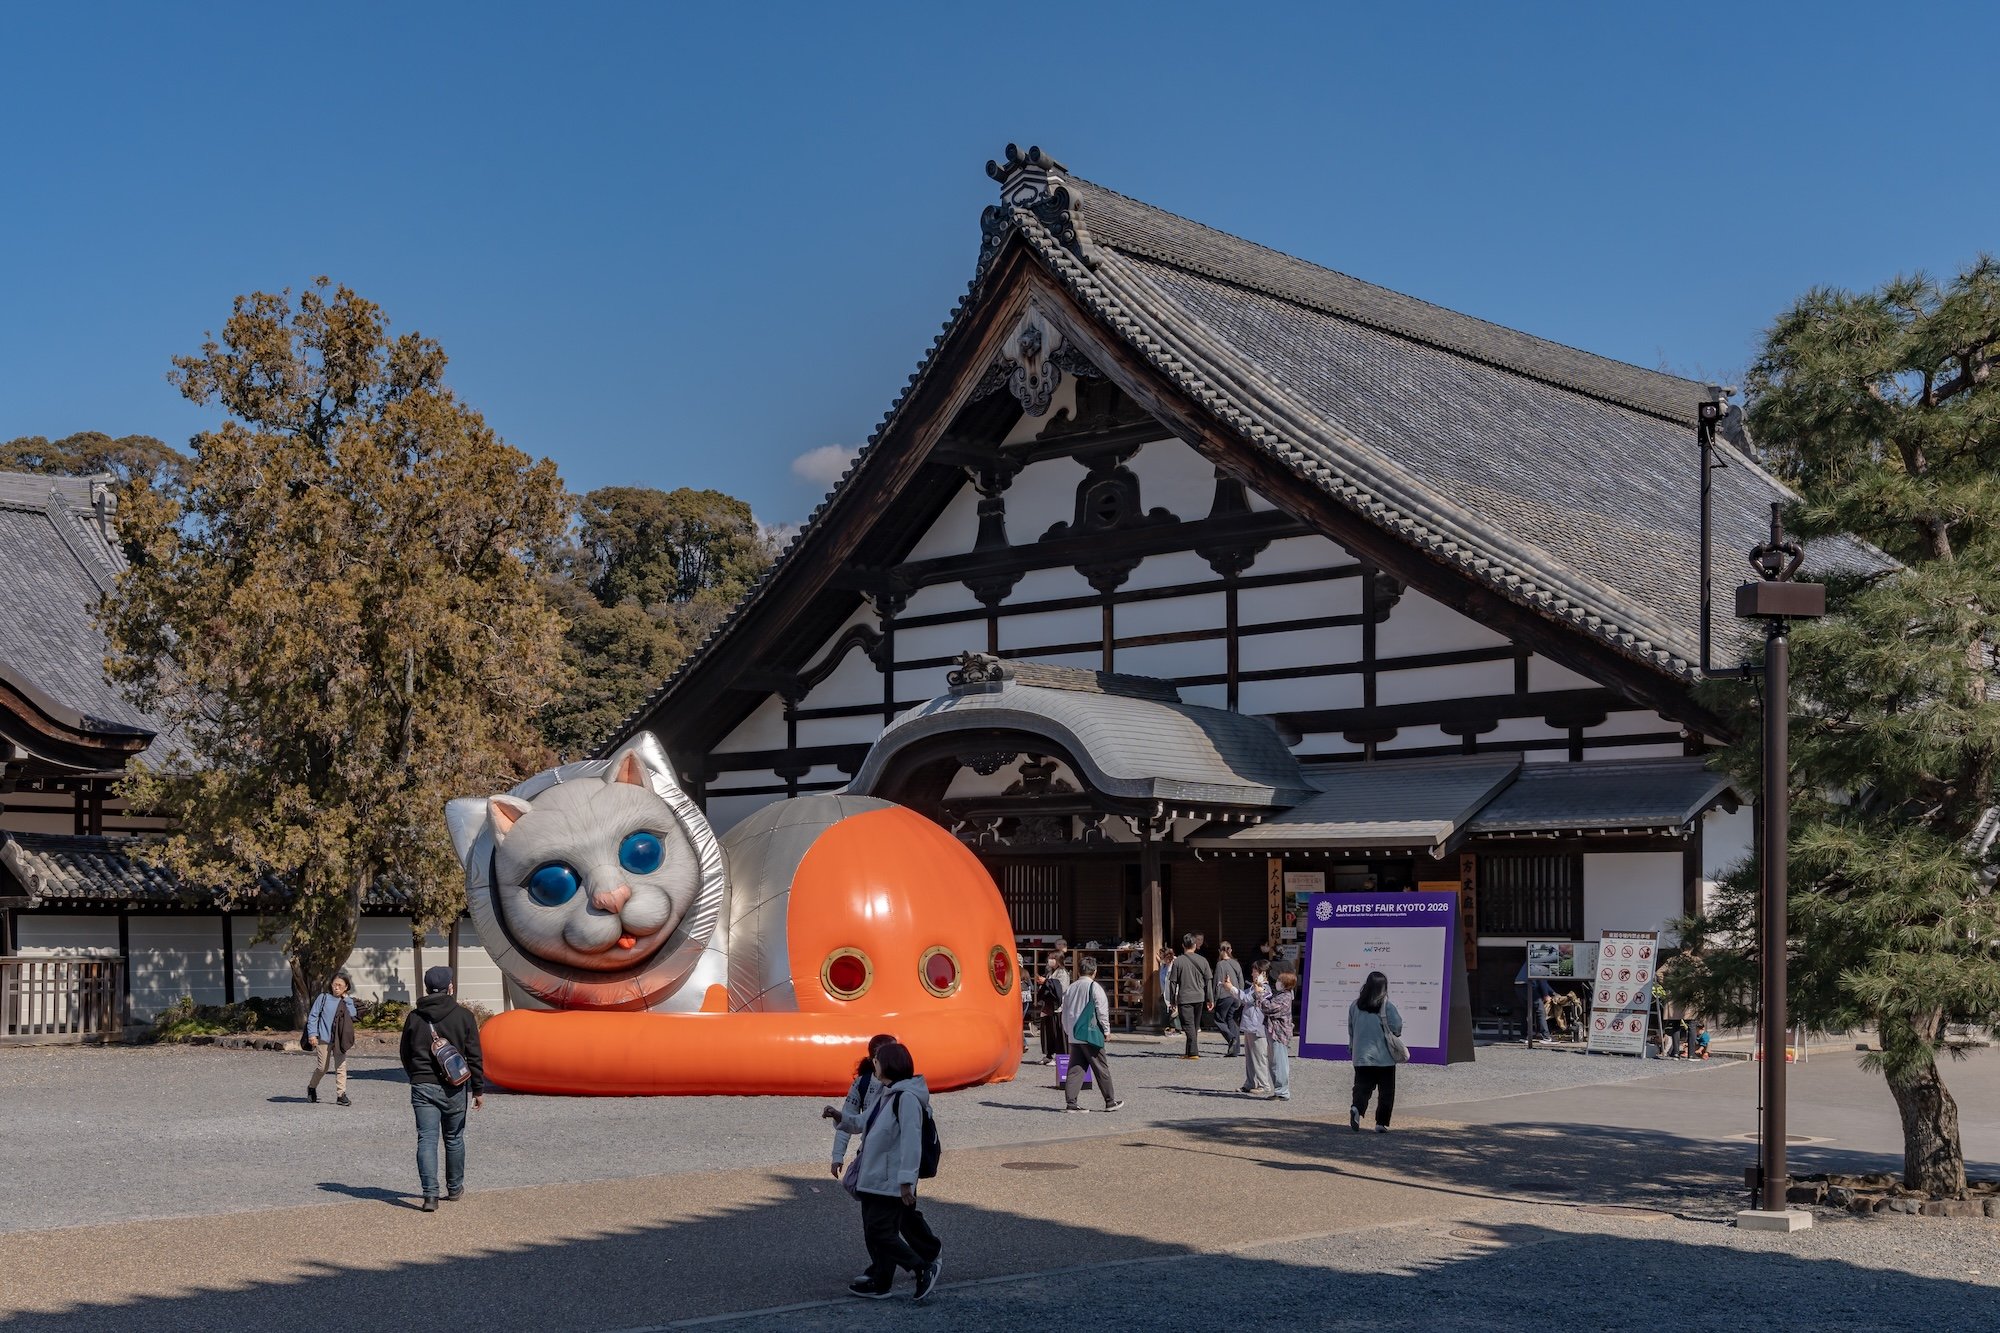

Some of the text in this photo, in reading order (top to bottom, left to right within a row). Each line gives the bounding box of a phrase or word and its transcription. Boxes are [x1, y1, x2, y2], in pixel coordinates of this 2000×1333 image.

[1375, 904, 1395, 912] FAIR
[1396, 903, 1426, 912] KYOTO
[1427, 903, 1449, 911] 2026
